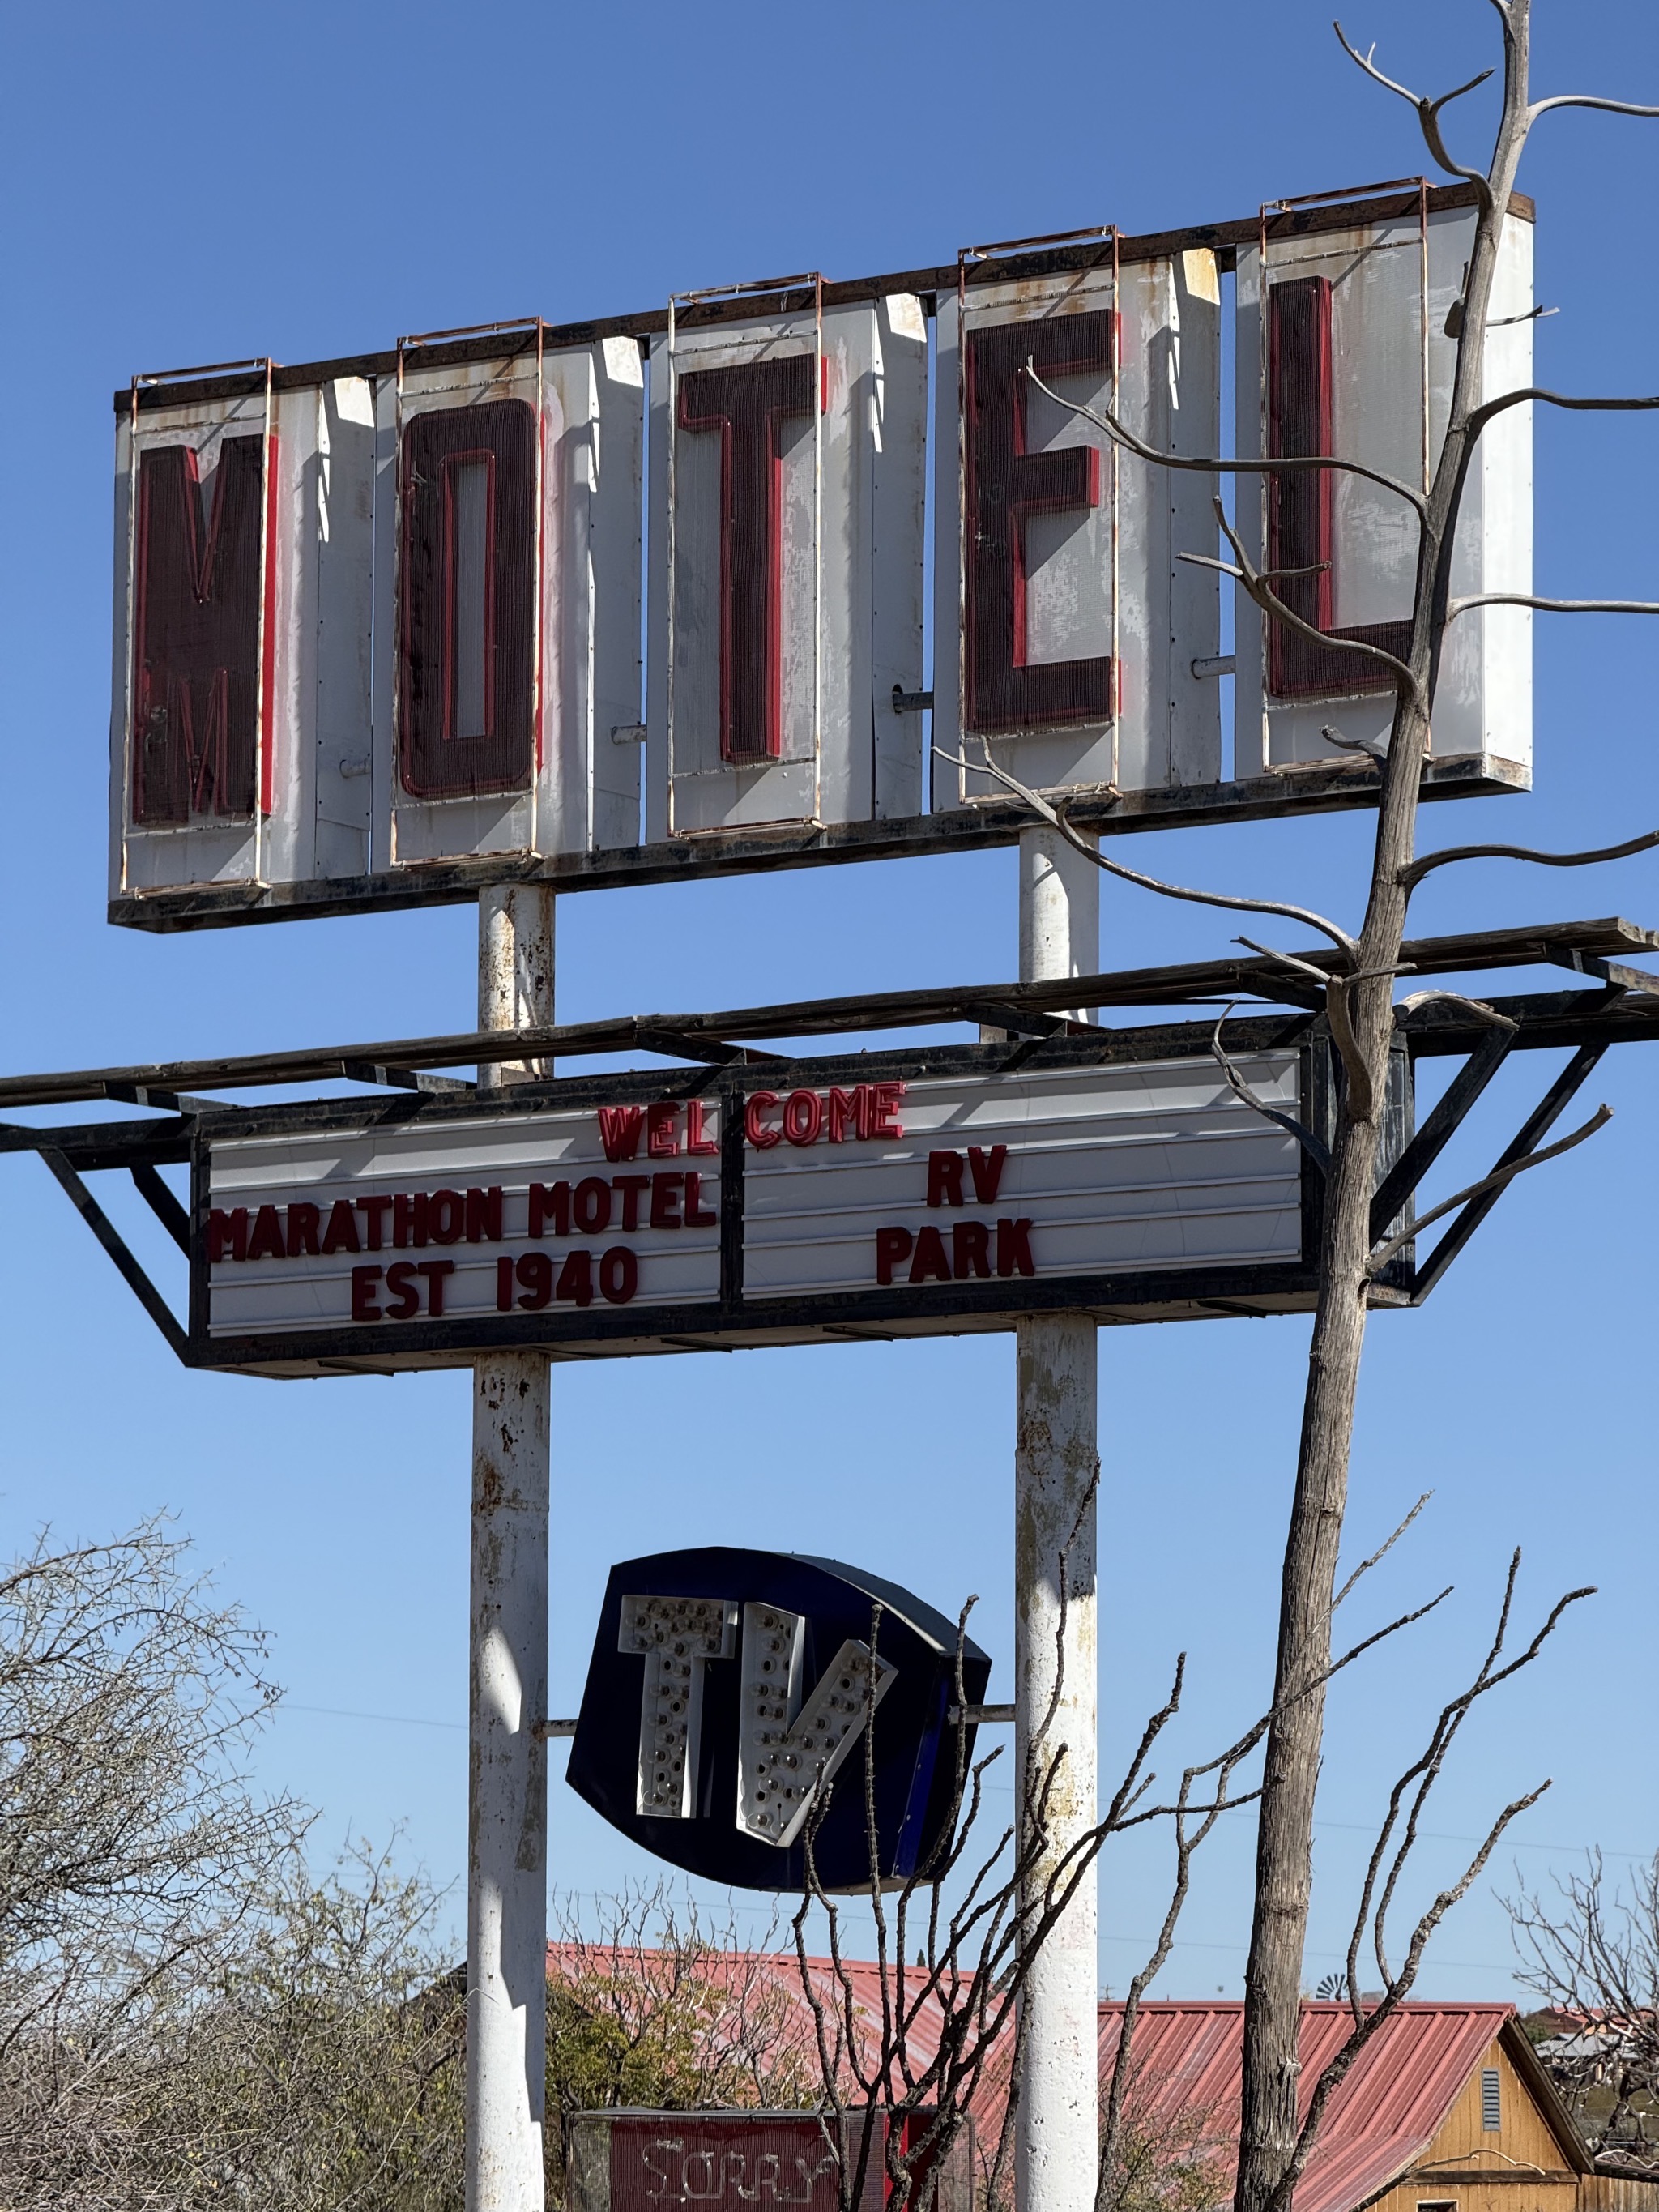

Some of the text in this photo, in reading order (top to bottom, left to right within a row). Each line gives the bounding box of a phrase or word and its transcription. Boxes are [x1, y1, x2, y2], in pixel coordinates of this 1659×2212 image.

[131, 274, 1414, 826] MOTEL
[926, 1144, 1008, 1208] RV
[208, 1171, 717, 1263] MARATHON MOTEL
[876, 1218, 1035, 1286] PARK
[351, 1246, 638, 1322] EST 1940
[617, 1595, 899, 1848] TV
[642, 2137, 837, 2204] SORRY
